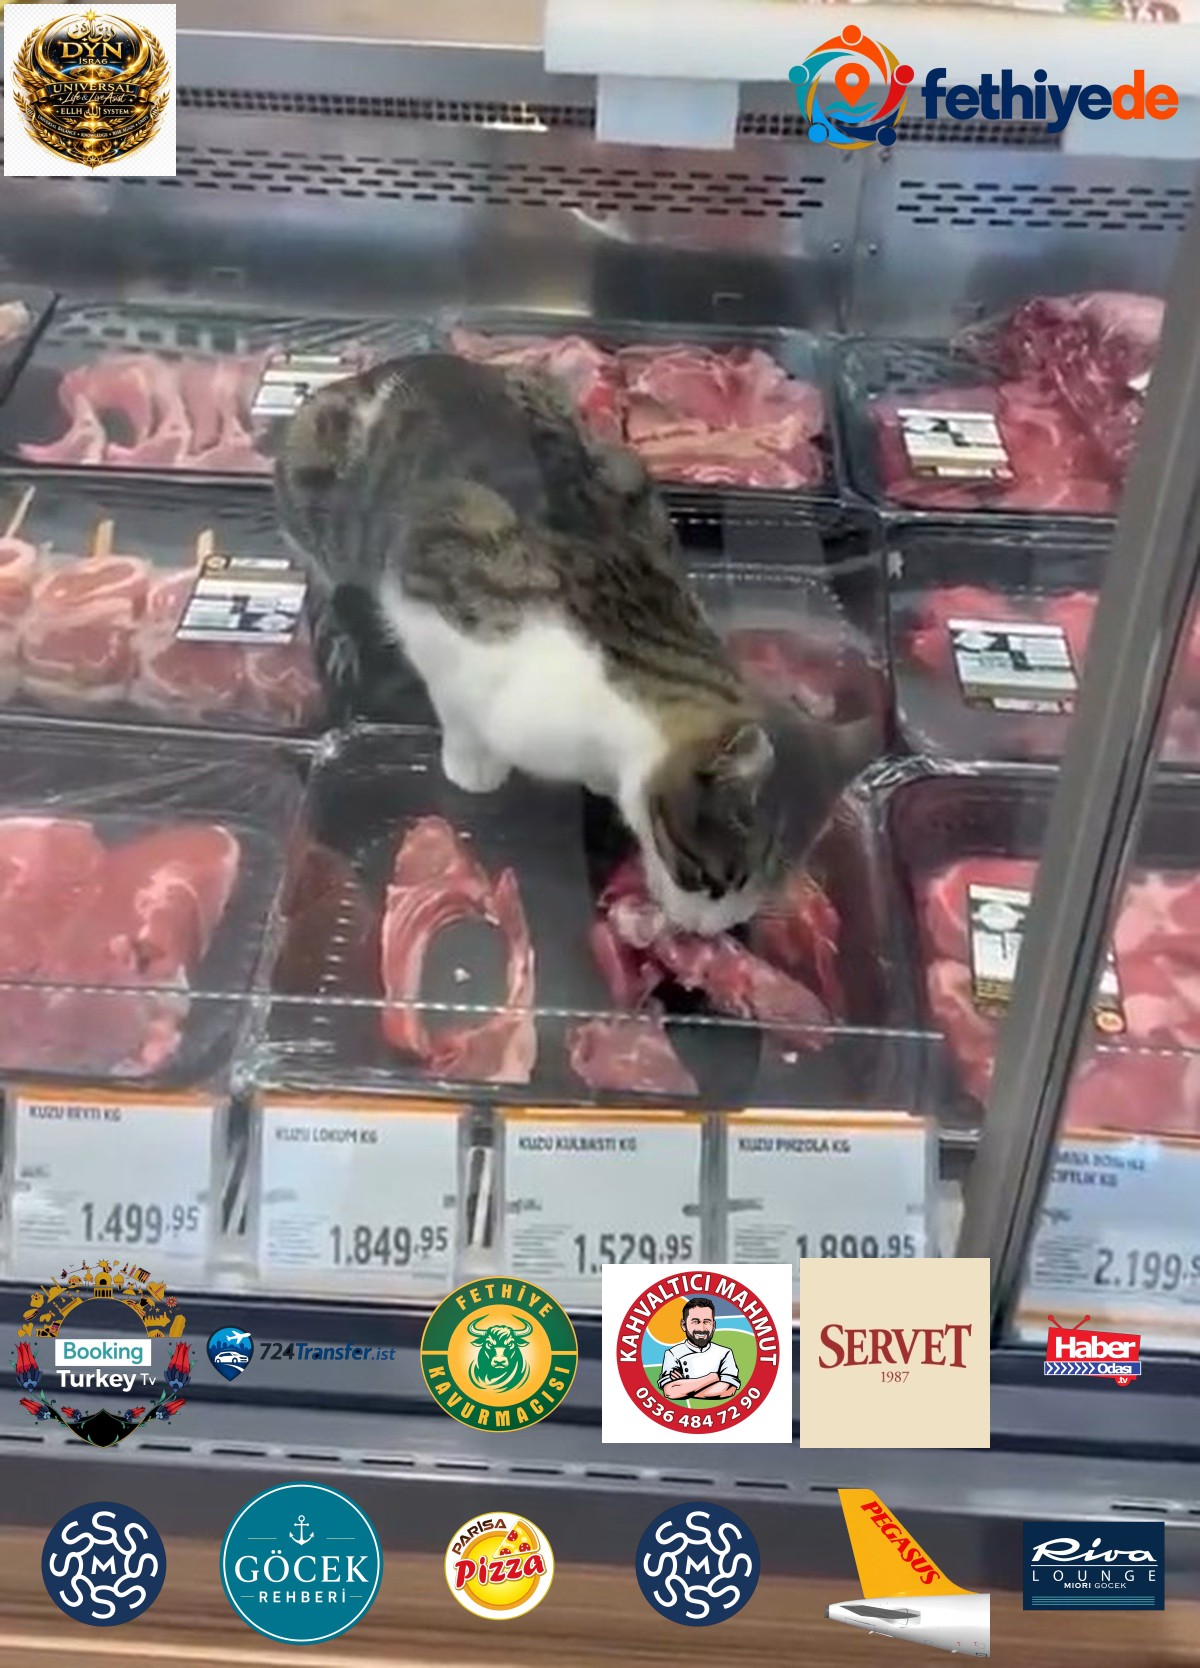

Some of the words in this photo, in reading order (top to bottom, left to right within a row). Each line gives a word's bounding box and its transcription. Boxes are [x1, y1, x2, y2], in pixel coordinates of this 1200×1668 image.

[104, 1107, 121, 1121] KG
[360, 1129, 378, 1143] KG
[619, 1137, 638, 1151] KG
[832, 1138, 850, 1153] KG
